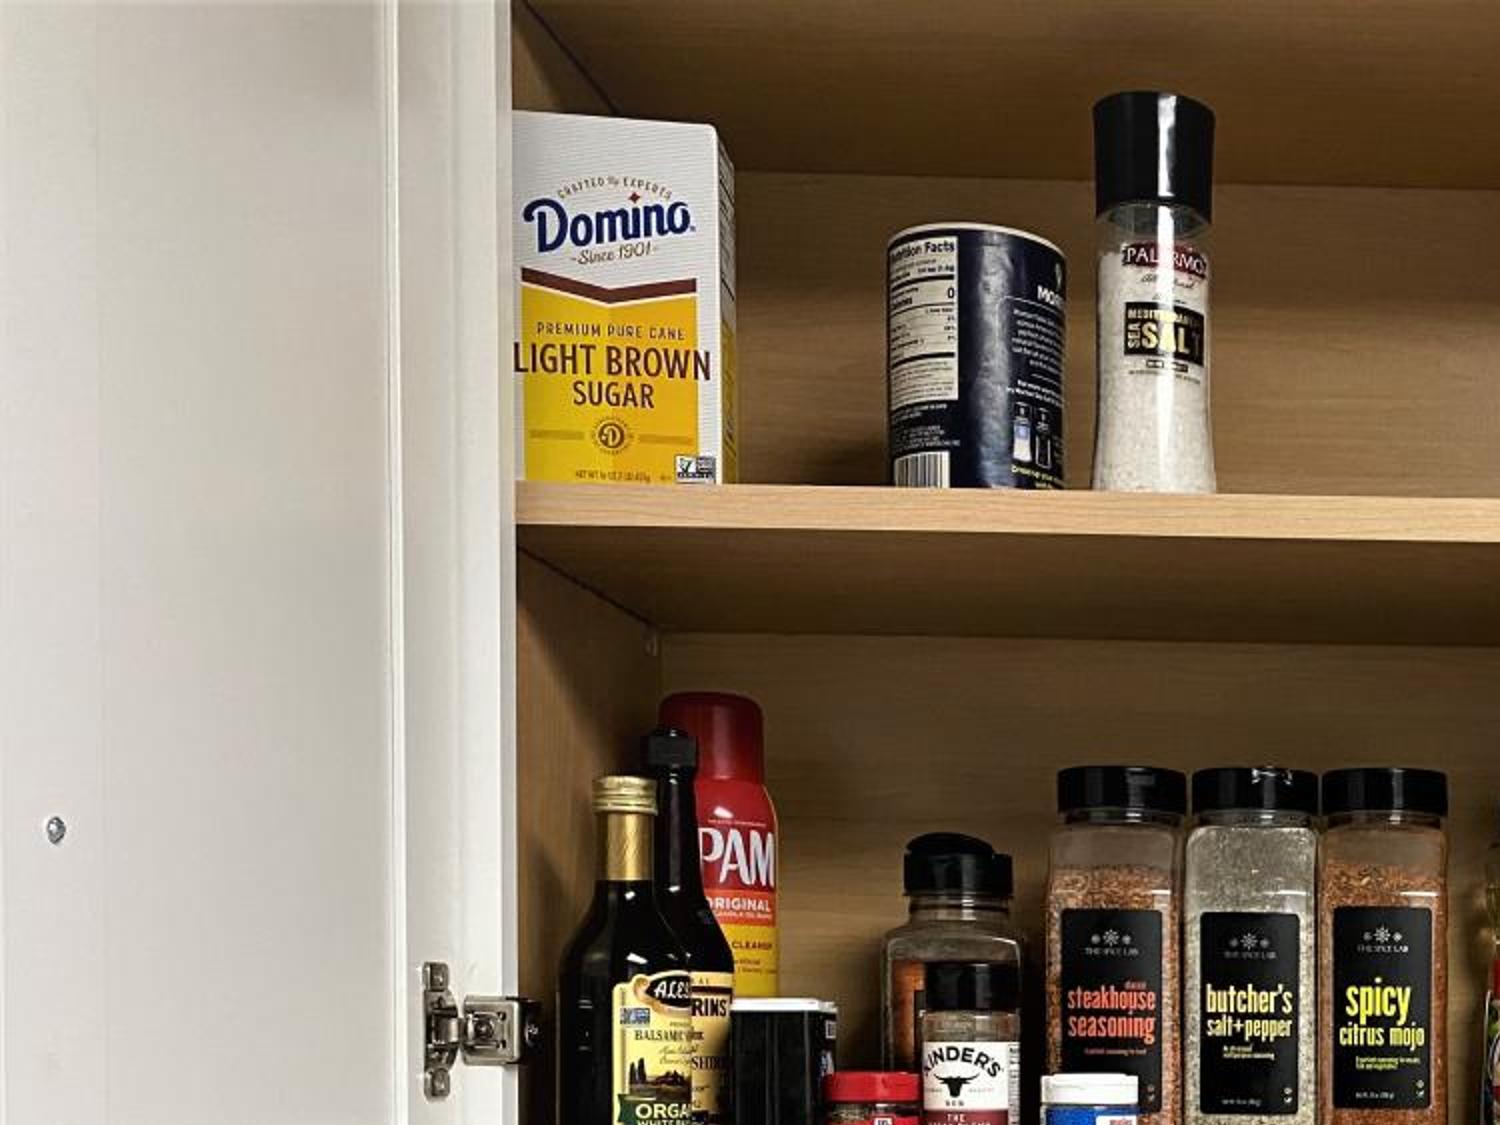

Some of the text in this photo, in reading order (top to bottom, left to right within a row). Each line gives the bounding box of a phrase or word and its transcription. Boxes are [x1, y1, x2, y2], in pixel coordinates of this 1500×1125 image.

[523, 192, 692, 253] Domino
[577, 242, 652, 265] Since 1901
[925, 241, 955, 254] Facts
[1126, 246, 1206, 273] PALRMO
[536, 321, 686, 342] PREMIUM PURE CANE
[1127, 322, 1141, 349] SEA
[513, 341, 712, 381] LIGHT BROWN
[572, 380, 656, 409] SUGAR
[698, 828, 776, 888] PAM
[691, 997, 728, 1017] RINS
[1066, 986, 1157, 1010] steakhouse
[1205, 983, 1294, 1014] butcher's
[1345, 976, 1412, 1026] spicy
[1066, 1010, 1157, 1045] seasoning
[1206, 1014, 1294, 1042] salt+pepper
[1338, 1021, 1426, 1052] citrus mojo
[924, 1045, 1002, 1078] KINDER'S
[635, 1103, 690, 1119] ORGA
[947, 1113, 966, 1122] THE
